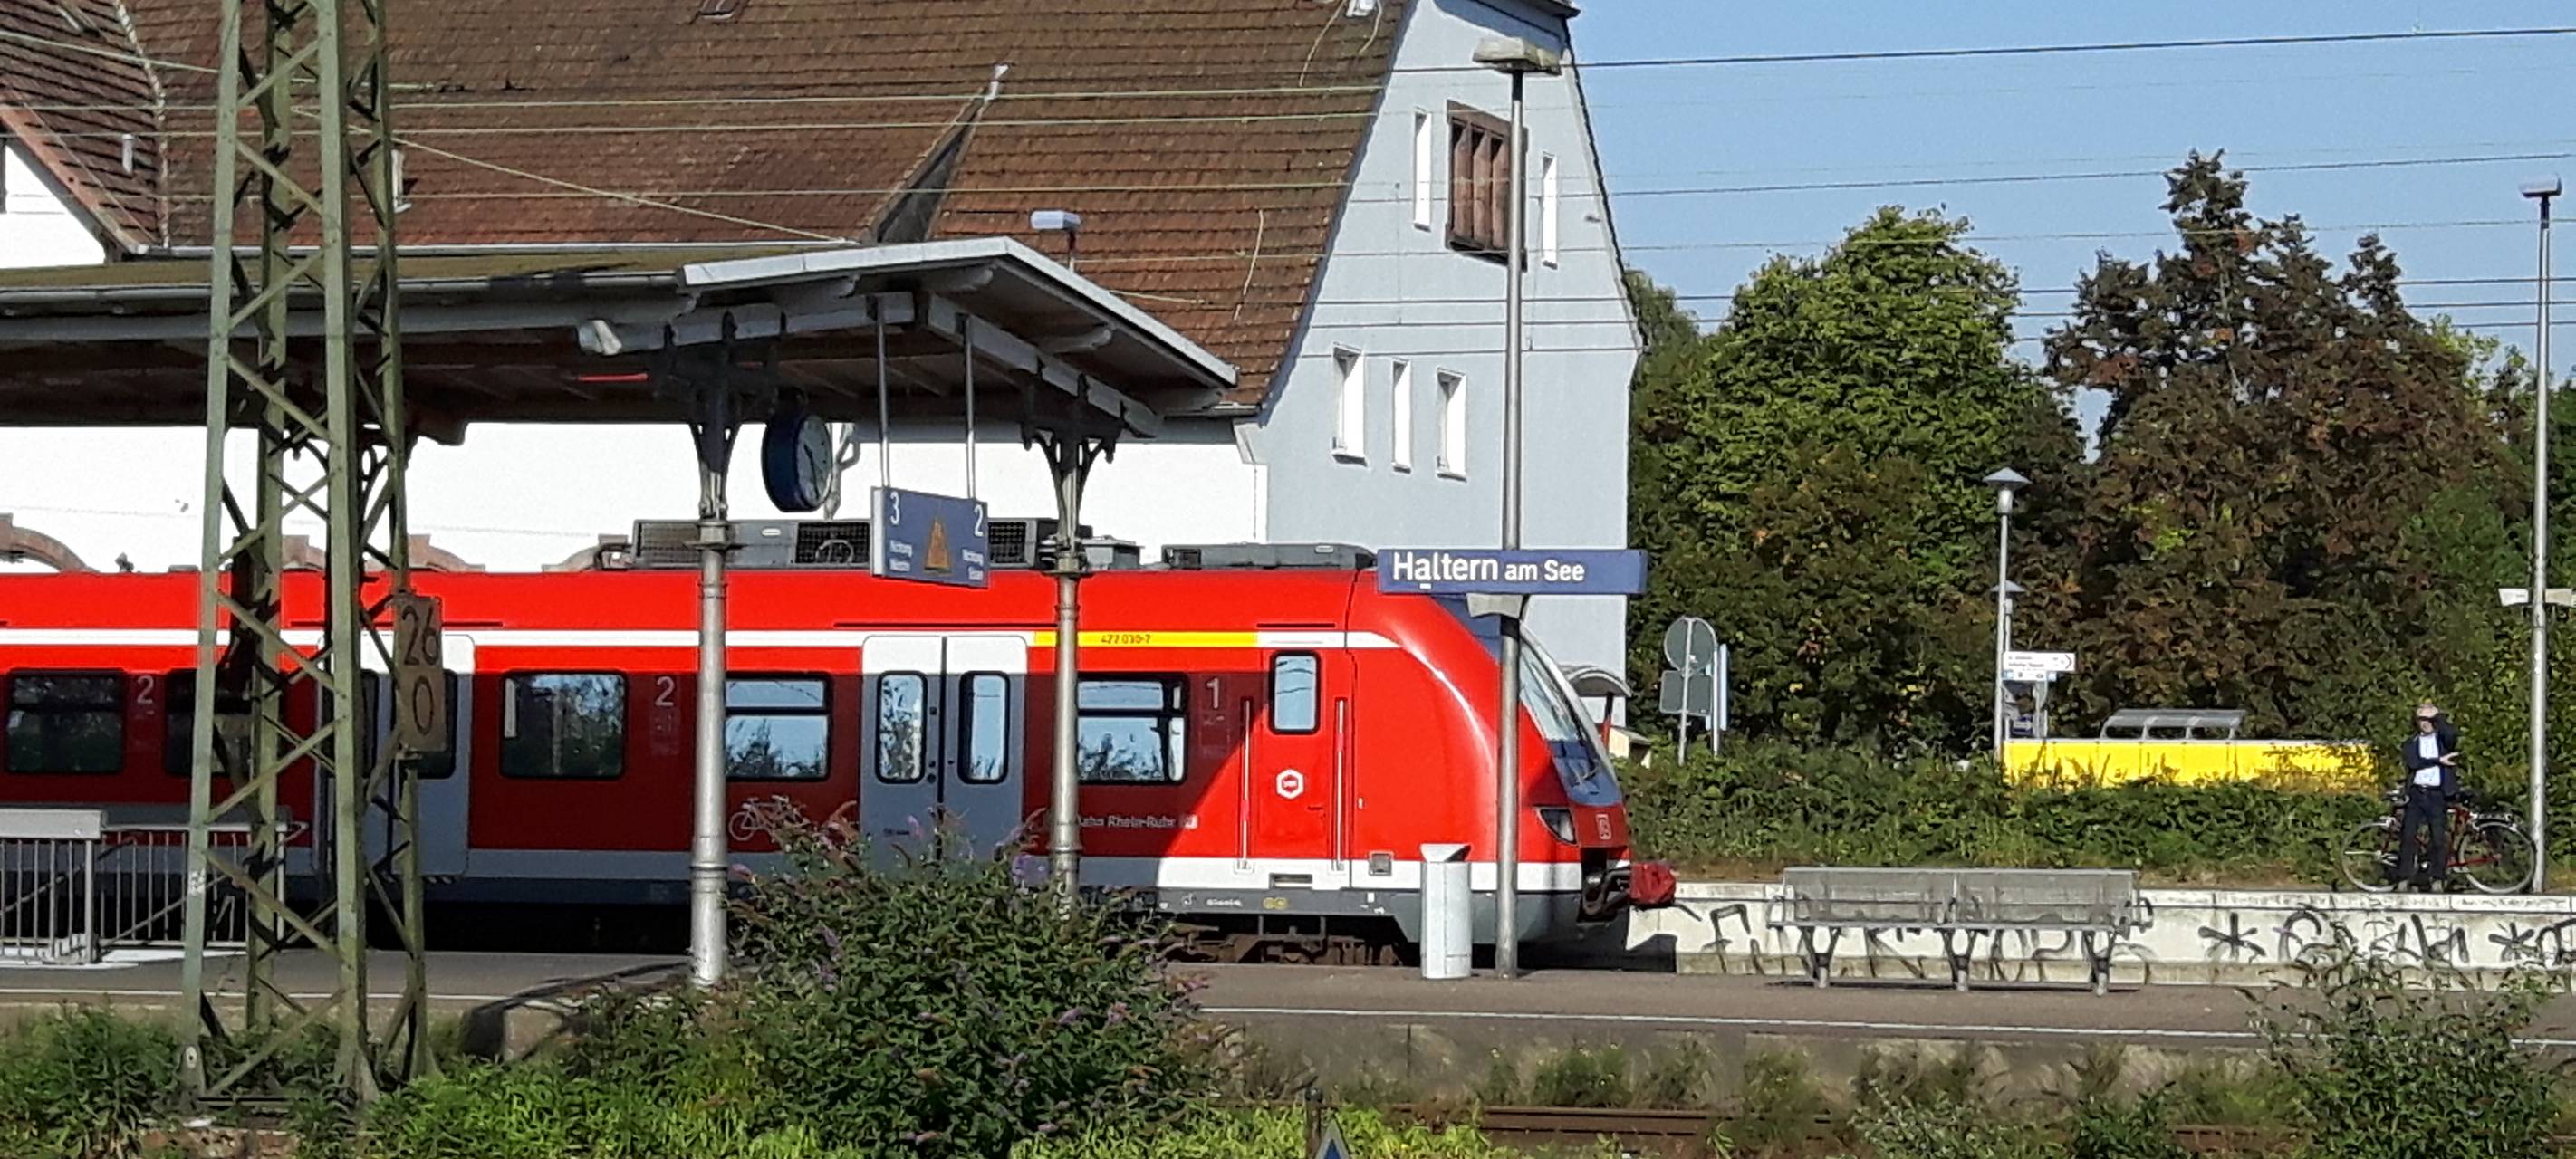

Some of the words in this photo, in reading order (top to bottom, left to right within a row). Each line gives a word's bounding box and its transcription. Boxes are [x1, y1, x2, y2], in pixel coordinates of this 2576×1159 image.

[890, 492, 900, 525] 3
[974, 504, 984, 537] 2
[1393, 551, 1499, 580] Haltern
[1504, 563, 1539, 581] am
[1543, 559, 1586, 581] See
[402, 605, 440, 666] 26
[137, 675, 154, 704] 2
[412, 676, 434, 735] 0
[655, 676, 676, 706] 2
[1206, 678, 1220, 709] 1
